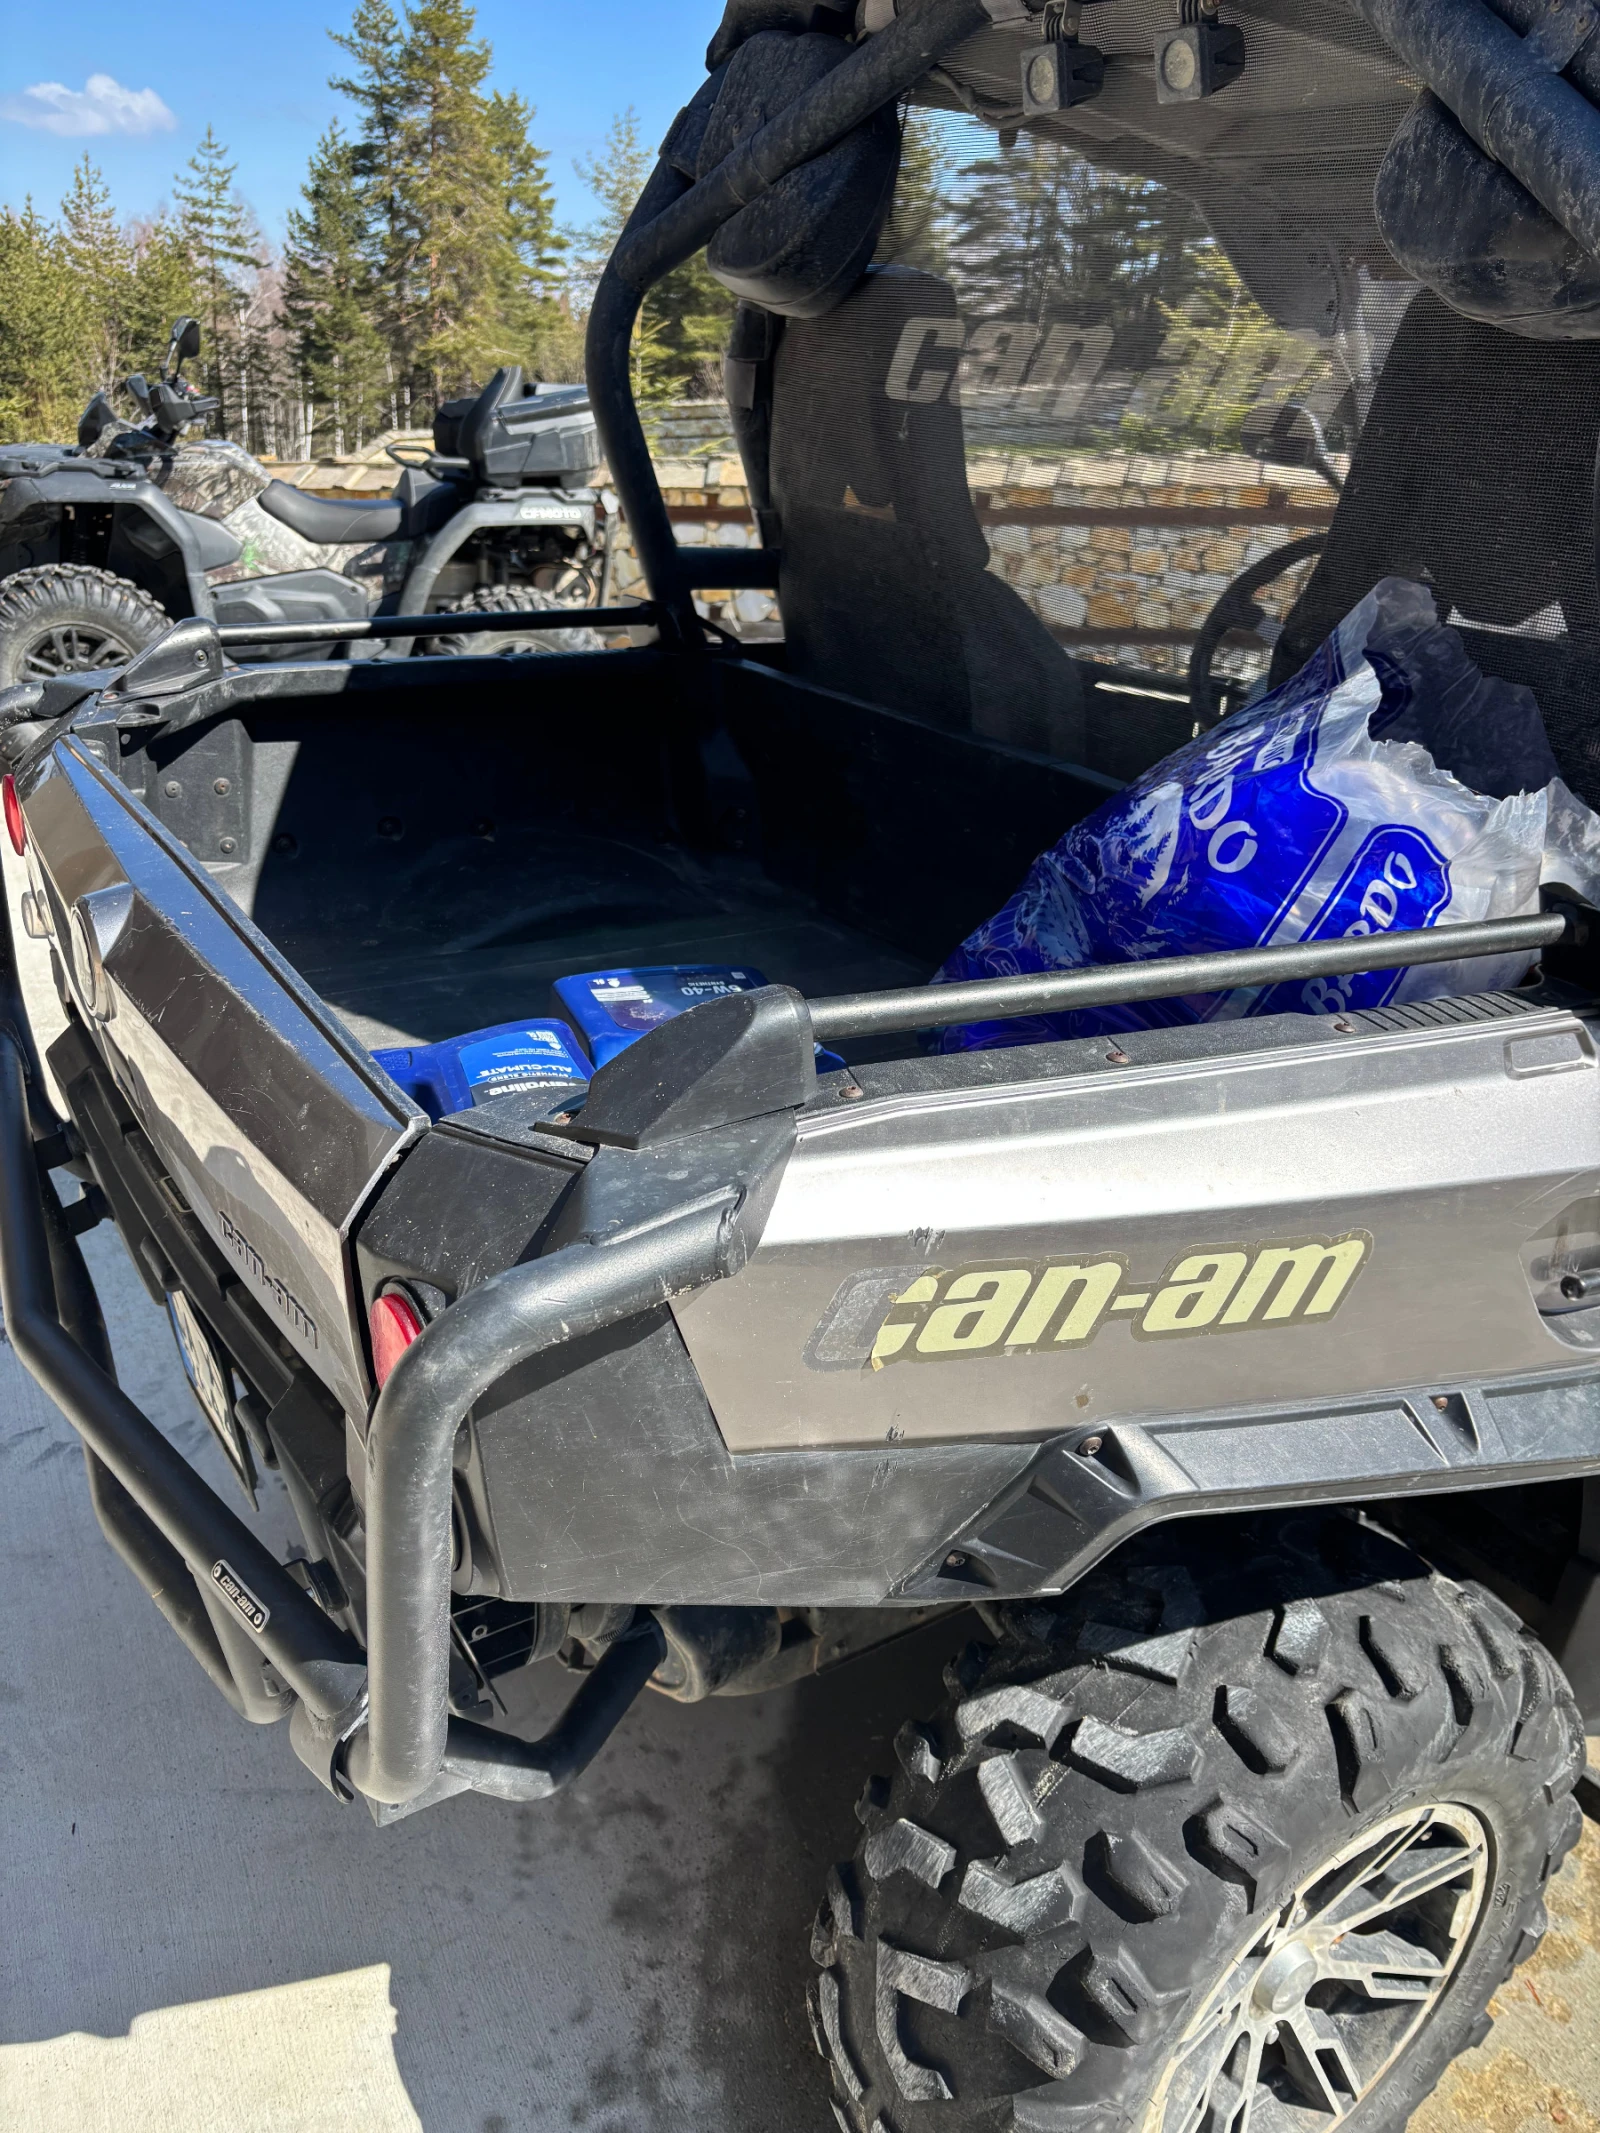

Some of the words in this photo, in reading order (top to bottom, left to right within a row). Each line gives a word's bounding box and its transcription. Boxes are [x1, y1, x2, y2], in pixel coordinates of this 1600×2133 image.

[520, 507, 581, 519] CFMOTO
[681, 984, 742, 996] 5W-40
[480, 1063, 573, 1077] ALL-CLIMATE
[220, 1575, 256, 1617] can-am
